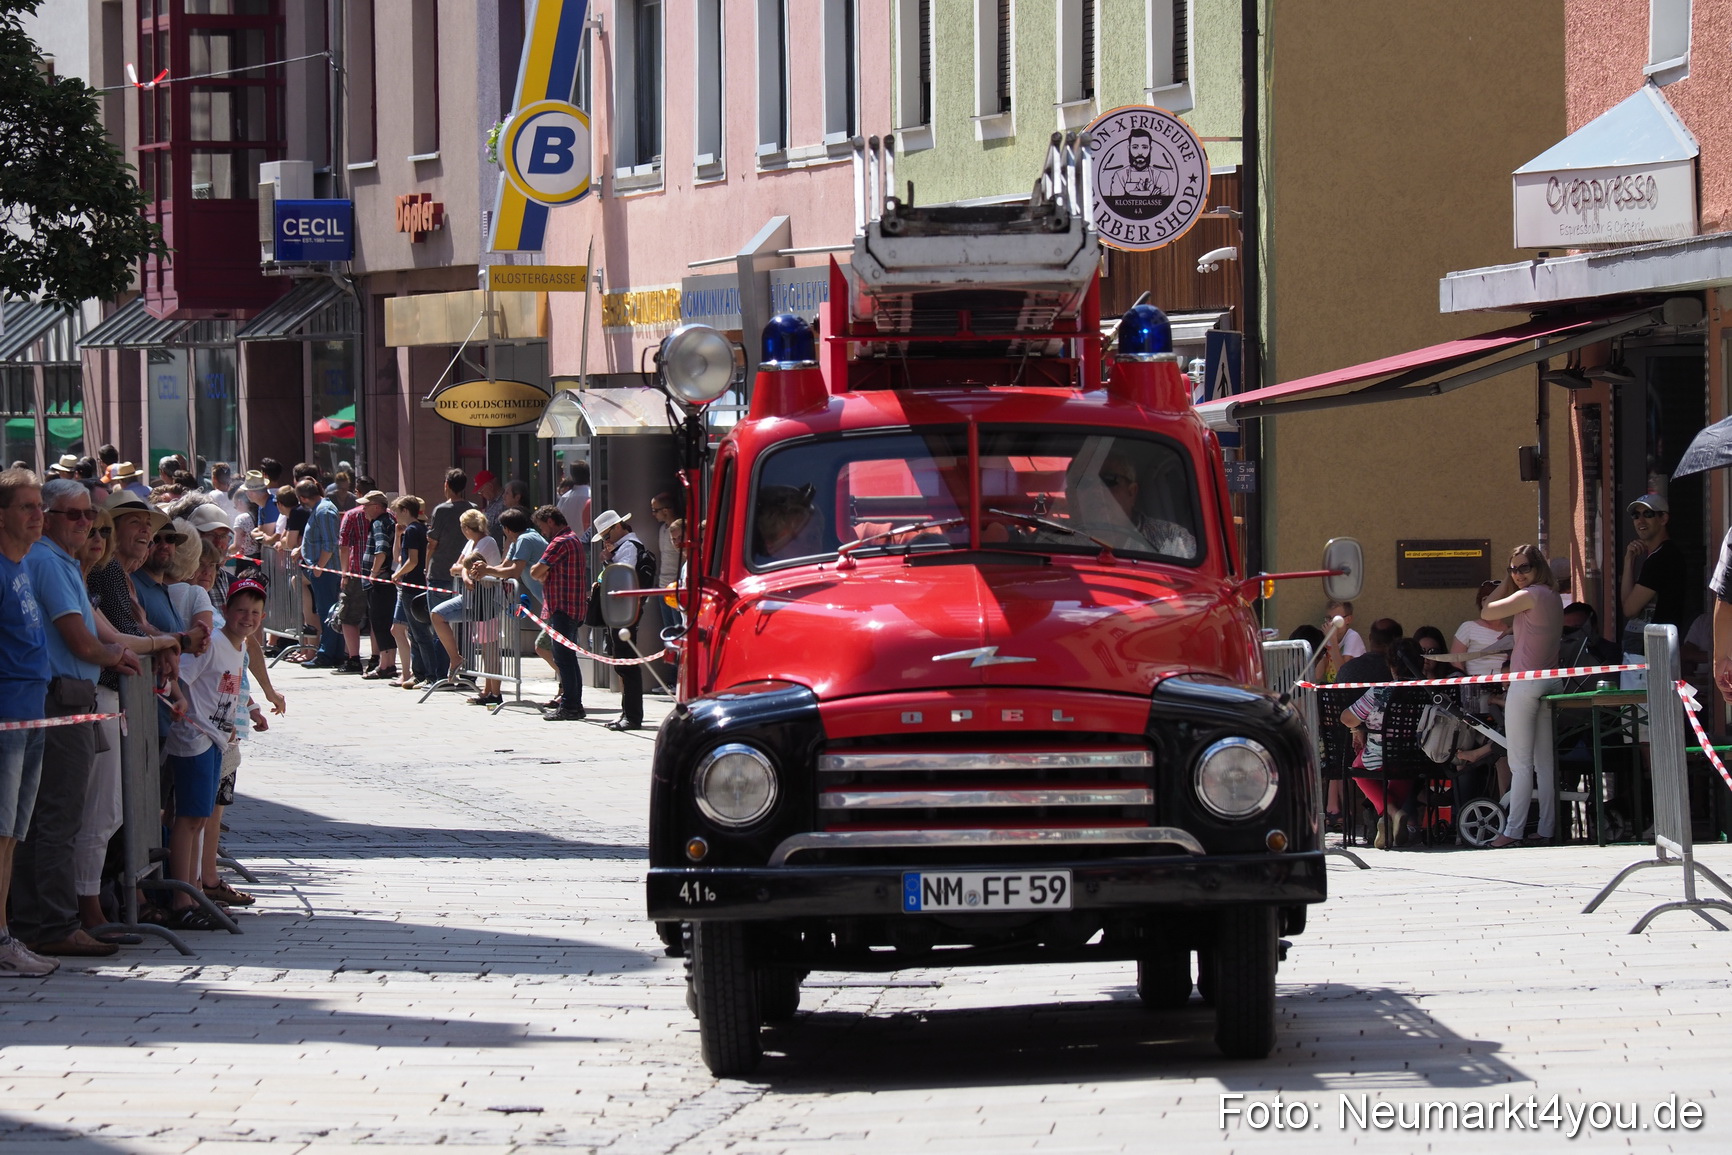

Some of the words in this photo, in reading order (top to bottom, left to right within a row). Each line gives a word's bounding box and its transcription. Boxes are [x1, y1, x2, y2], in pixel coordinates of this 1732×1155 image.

[527, 125, 576, 174] B
[1090, 118, 1127, 161] ON-X
[1130, 115, 1196, 163] FRISEURE
[1092, 186, 1150, 241] RBER
[1154, 185, 1198, 237] SHOP
[1546, 175, 1658, 225] Creppresso
[283, 218, 344, 236] CECIL
[395, 193, 434, 244] Döpfer
[494, 273, 576, 284] KLOSTERGASSE
[682, 288, 742, 320] KOMMUNIKATIO
[770, 277, 828, 314] BÜROELEKTR
[440, 400, 459, 409] DIE
[461, 399, 547, 409] GOLDSCHMIEDE
[1238, 465, 1245, 473] S
[901, 709, 1075, 724] OPEL
[679, 881, 700, 905] 4,1
[909, 895, 916, 905] D
[923, 876, 963, 906] NM
[982, 876, 1022, 906] FF
[1029, 875, 1066, 904] 59
